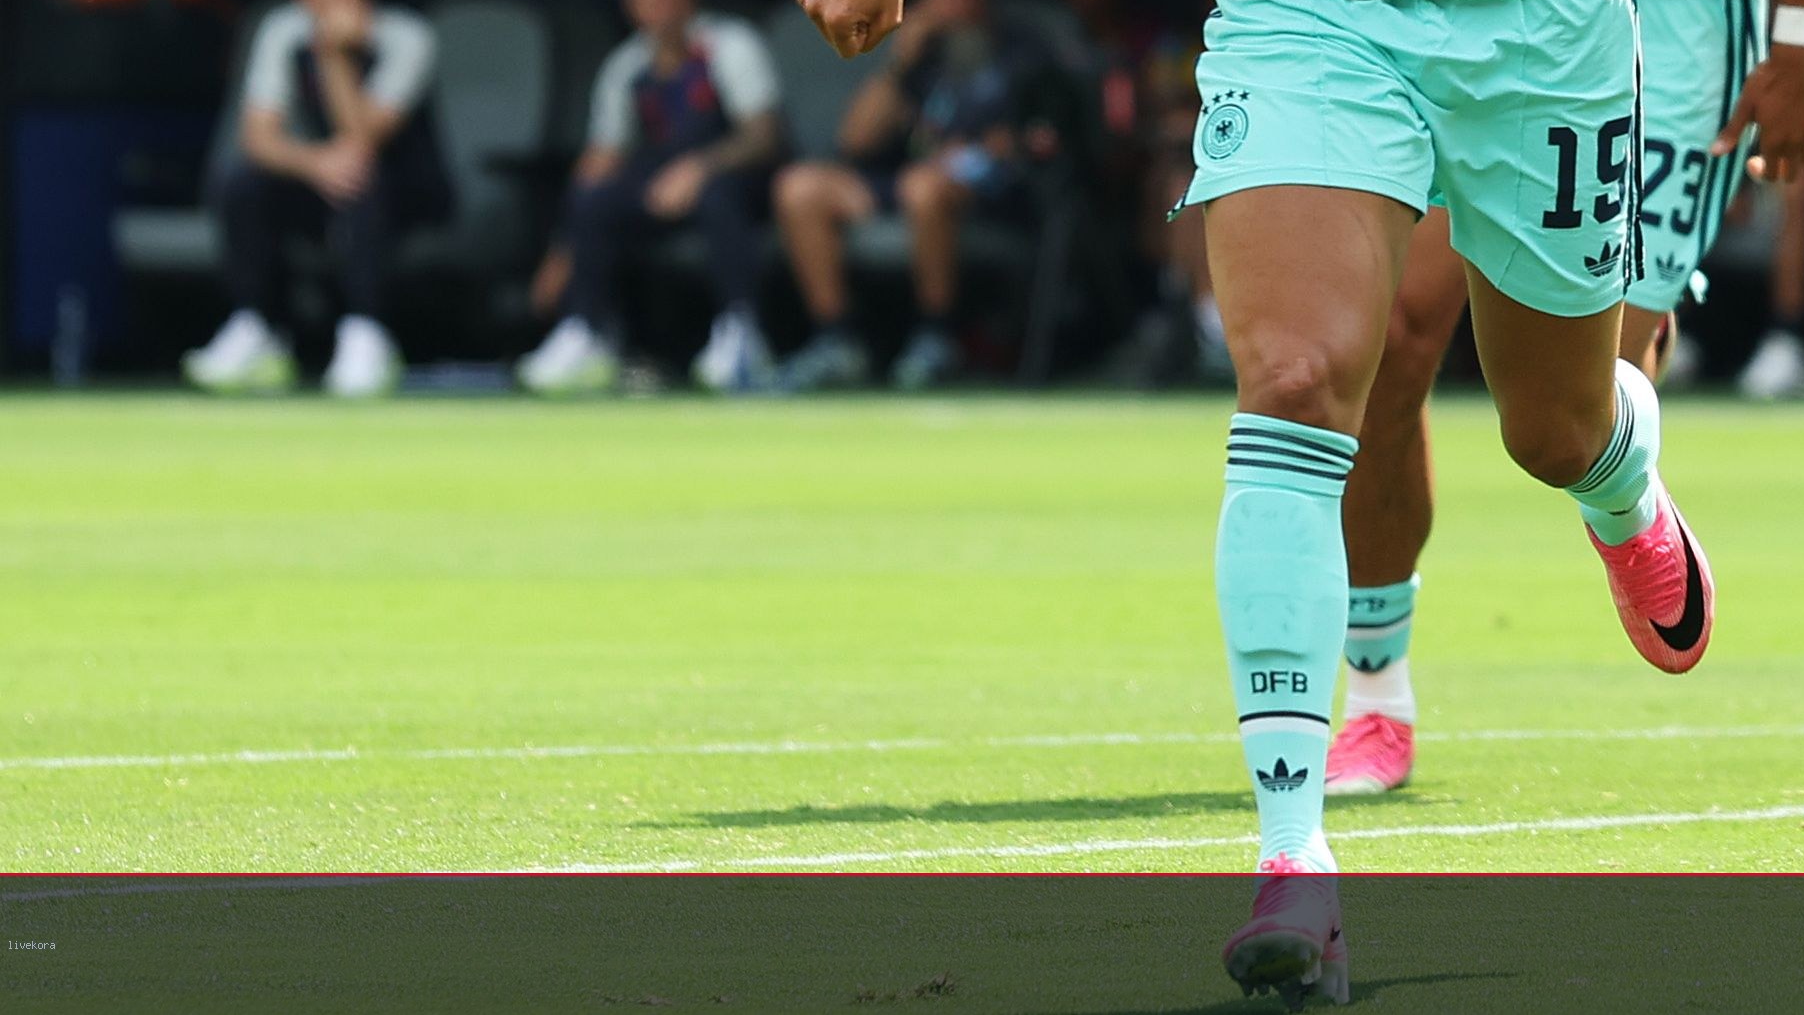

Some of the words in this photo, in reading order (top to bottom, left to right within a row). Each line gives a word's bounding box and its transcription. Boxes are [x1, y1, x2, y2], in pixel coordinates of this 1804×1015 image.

[1542, 115, 1633, 228] 19
[1641, 138, 1709, 239] 23
[1251, 670, 1309, 694] DFB
